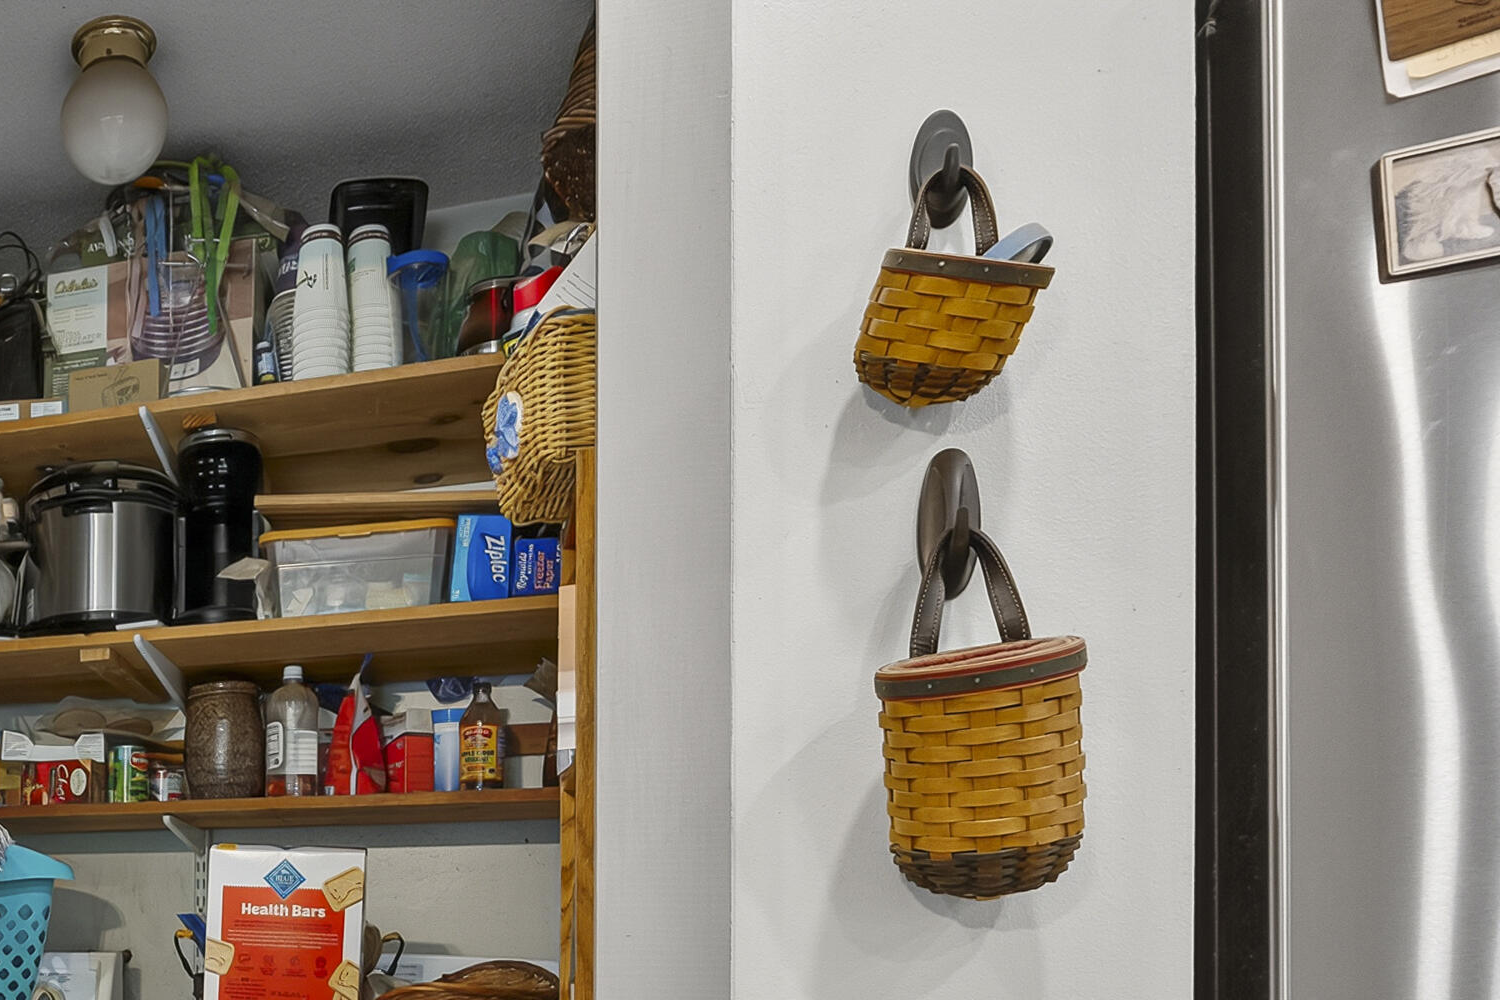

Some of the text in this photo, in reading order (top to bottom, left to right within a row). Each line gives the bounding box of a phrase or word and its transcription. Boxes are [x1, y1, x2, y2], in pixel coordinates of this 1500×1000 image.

[484, 535, 507, 583] Ziploc
[516, 552, 528, 590] Reynolds
[534, 551, 545, 590] Freezer
[544, 559, 555, 589] Paper
[241, 902, 326, 918] Health Bars
